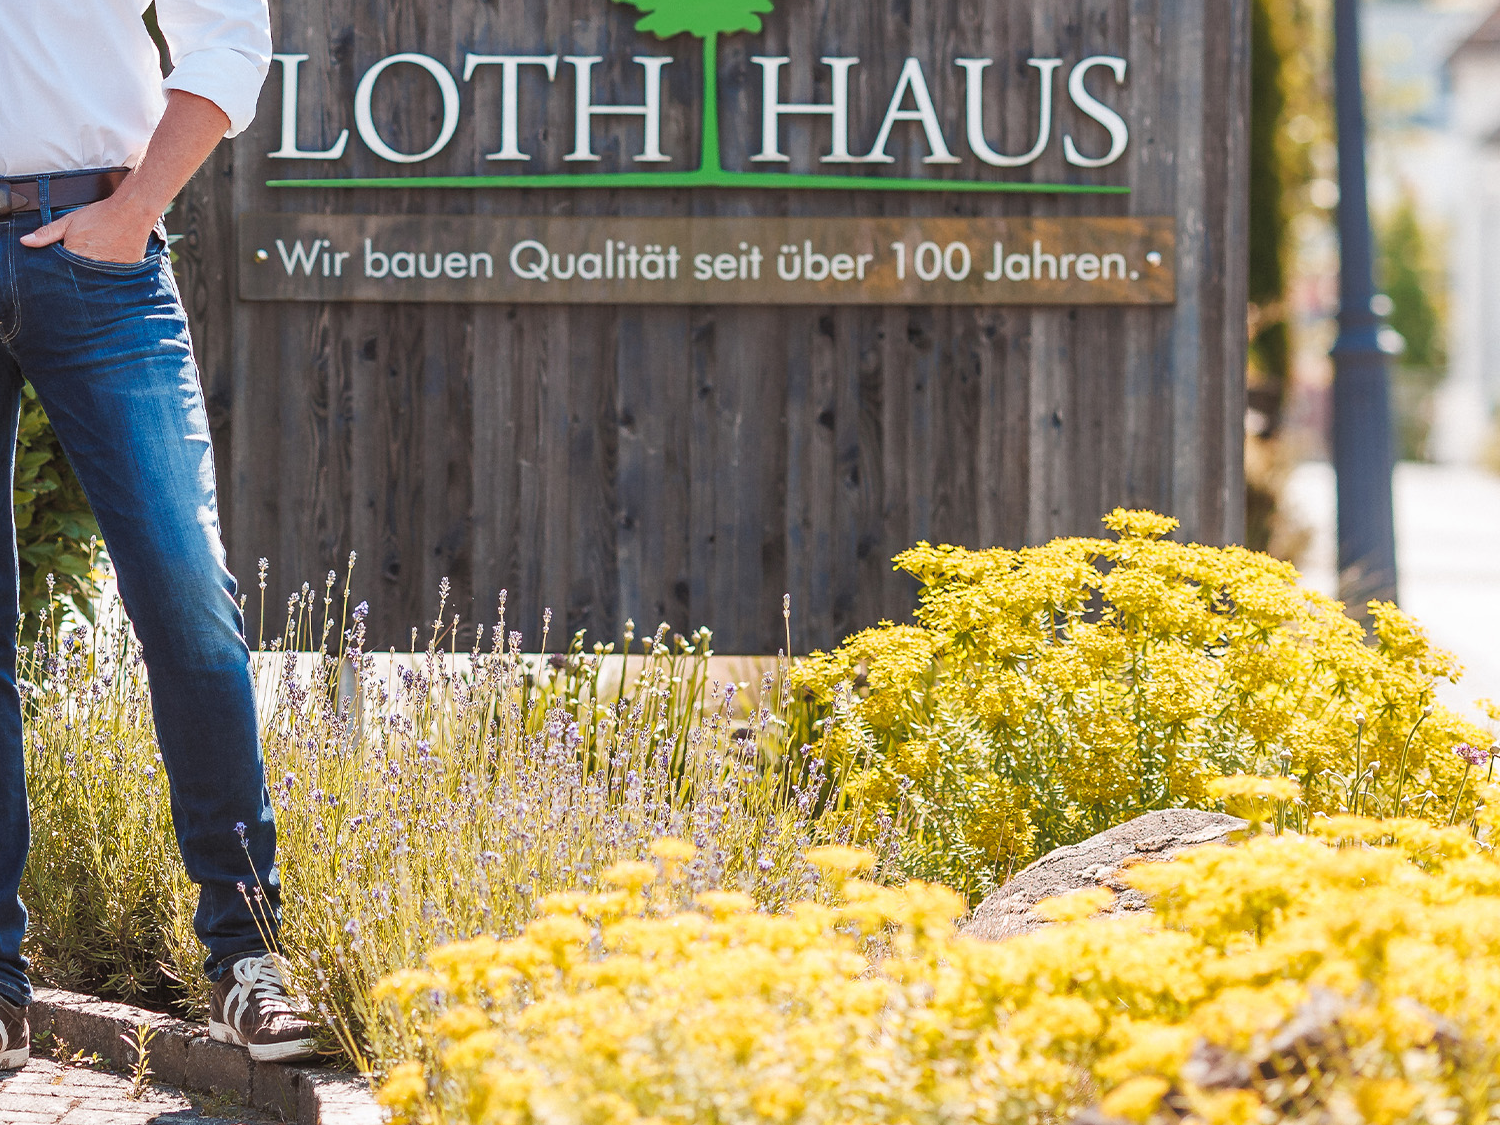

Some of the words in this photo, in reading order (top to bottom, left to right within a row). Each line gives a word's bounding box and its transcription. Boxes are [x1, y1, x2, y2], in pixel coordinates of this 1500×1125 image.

[267, 52, 674, 163] LOTH
[749, 55, 1130, 168] HAUS
[275, 239, 350, 277] Wir
[364, 238, 494, 279] bauen
[509, 239, 681, 282] Qualität
[693, 241, 764, 281] seit
[777, 239, 874, 281] über
[891, 241, 972, 281] 100
[984, 239, 1139, 281] Jahren.
